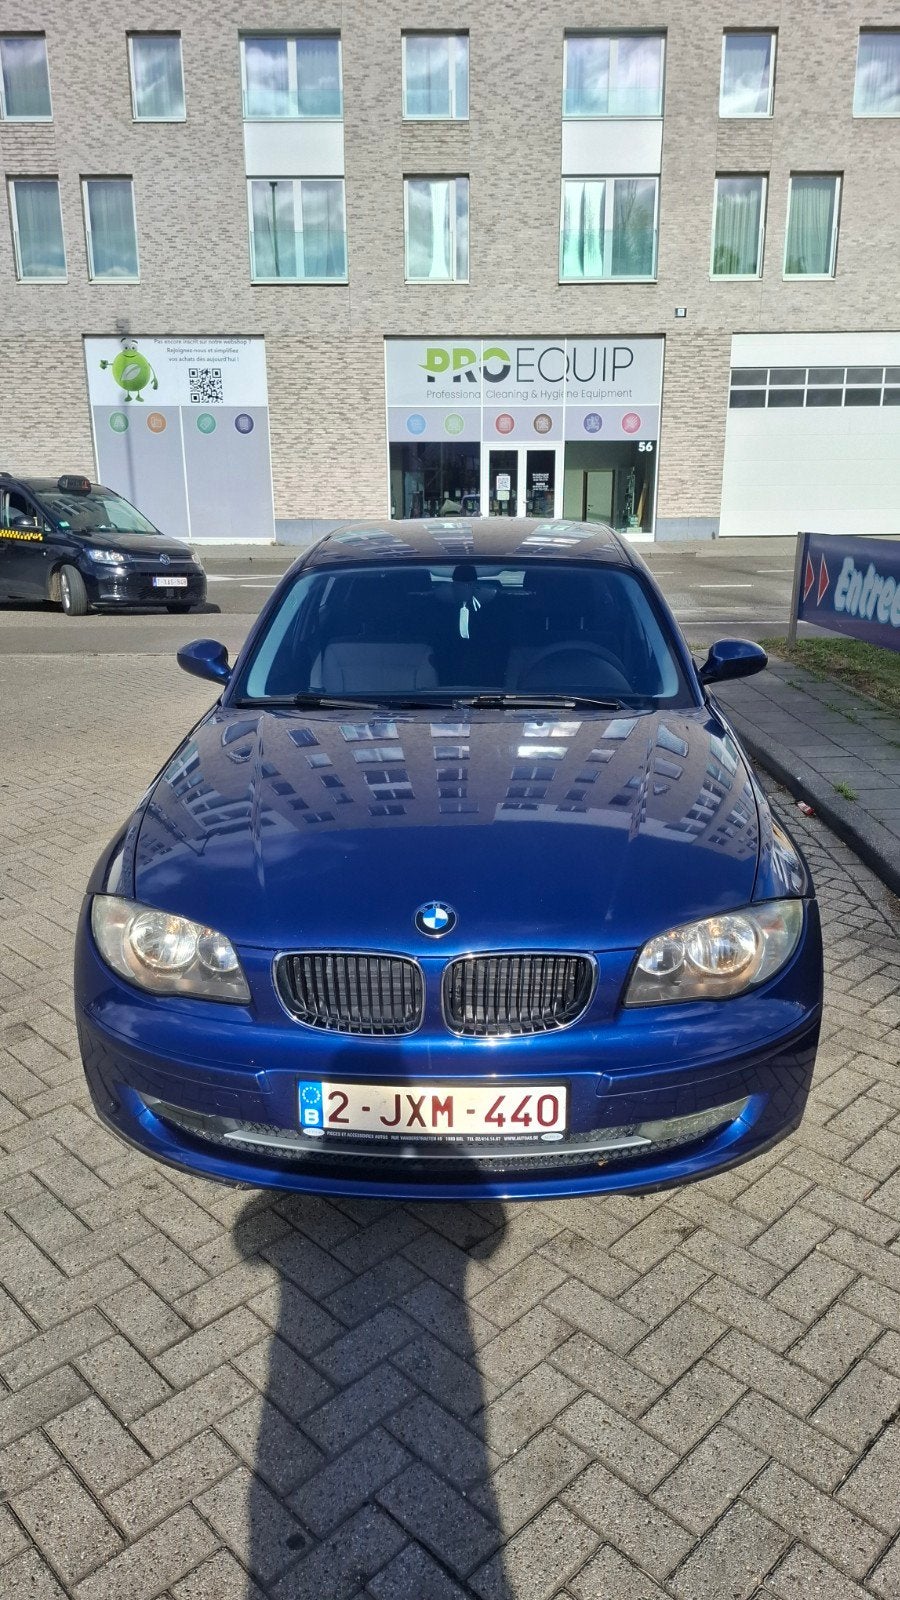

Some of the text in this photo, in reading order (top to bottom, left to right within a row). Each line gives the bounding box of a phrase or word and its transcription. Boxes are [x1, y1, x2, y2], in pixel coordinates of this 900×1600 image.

[426, 389, 481, 399] Professiona
[485, 388, 529, 401] Cleaning
[531, 389, 538, 398] &
[581, 388, 633, 400] Equipment
[637, 441, 654, 452] 56
[304, 1108, 320, 1125] B
